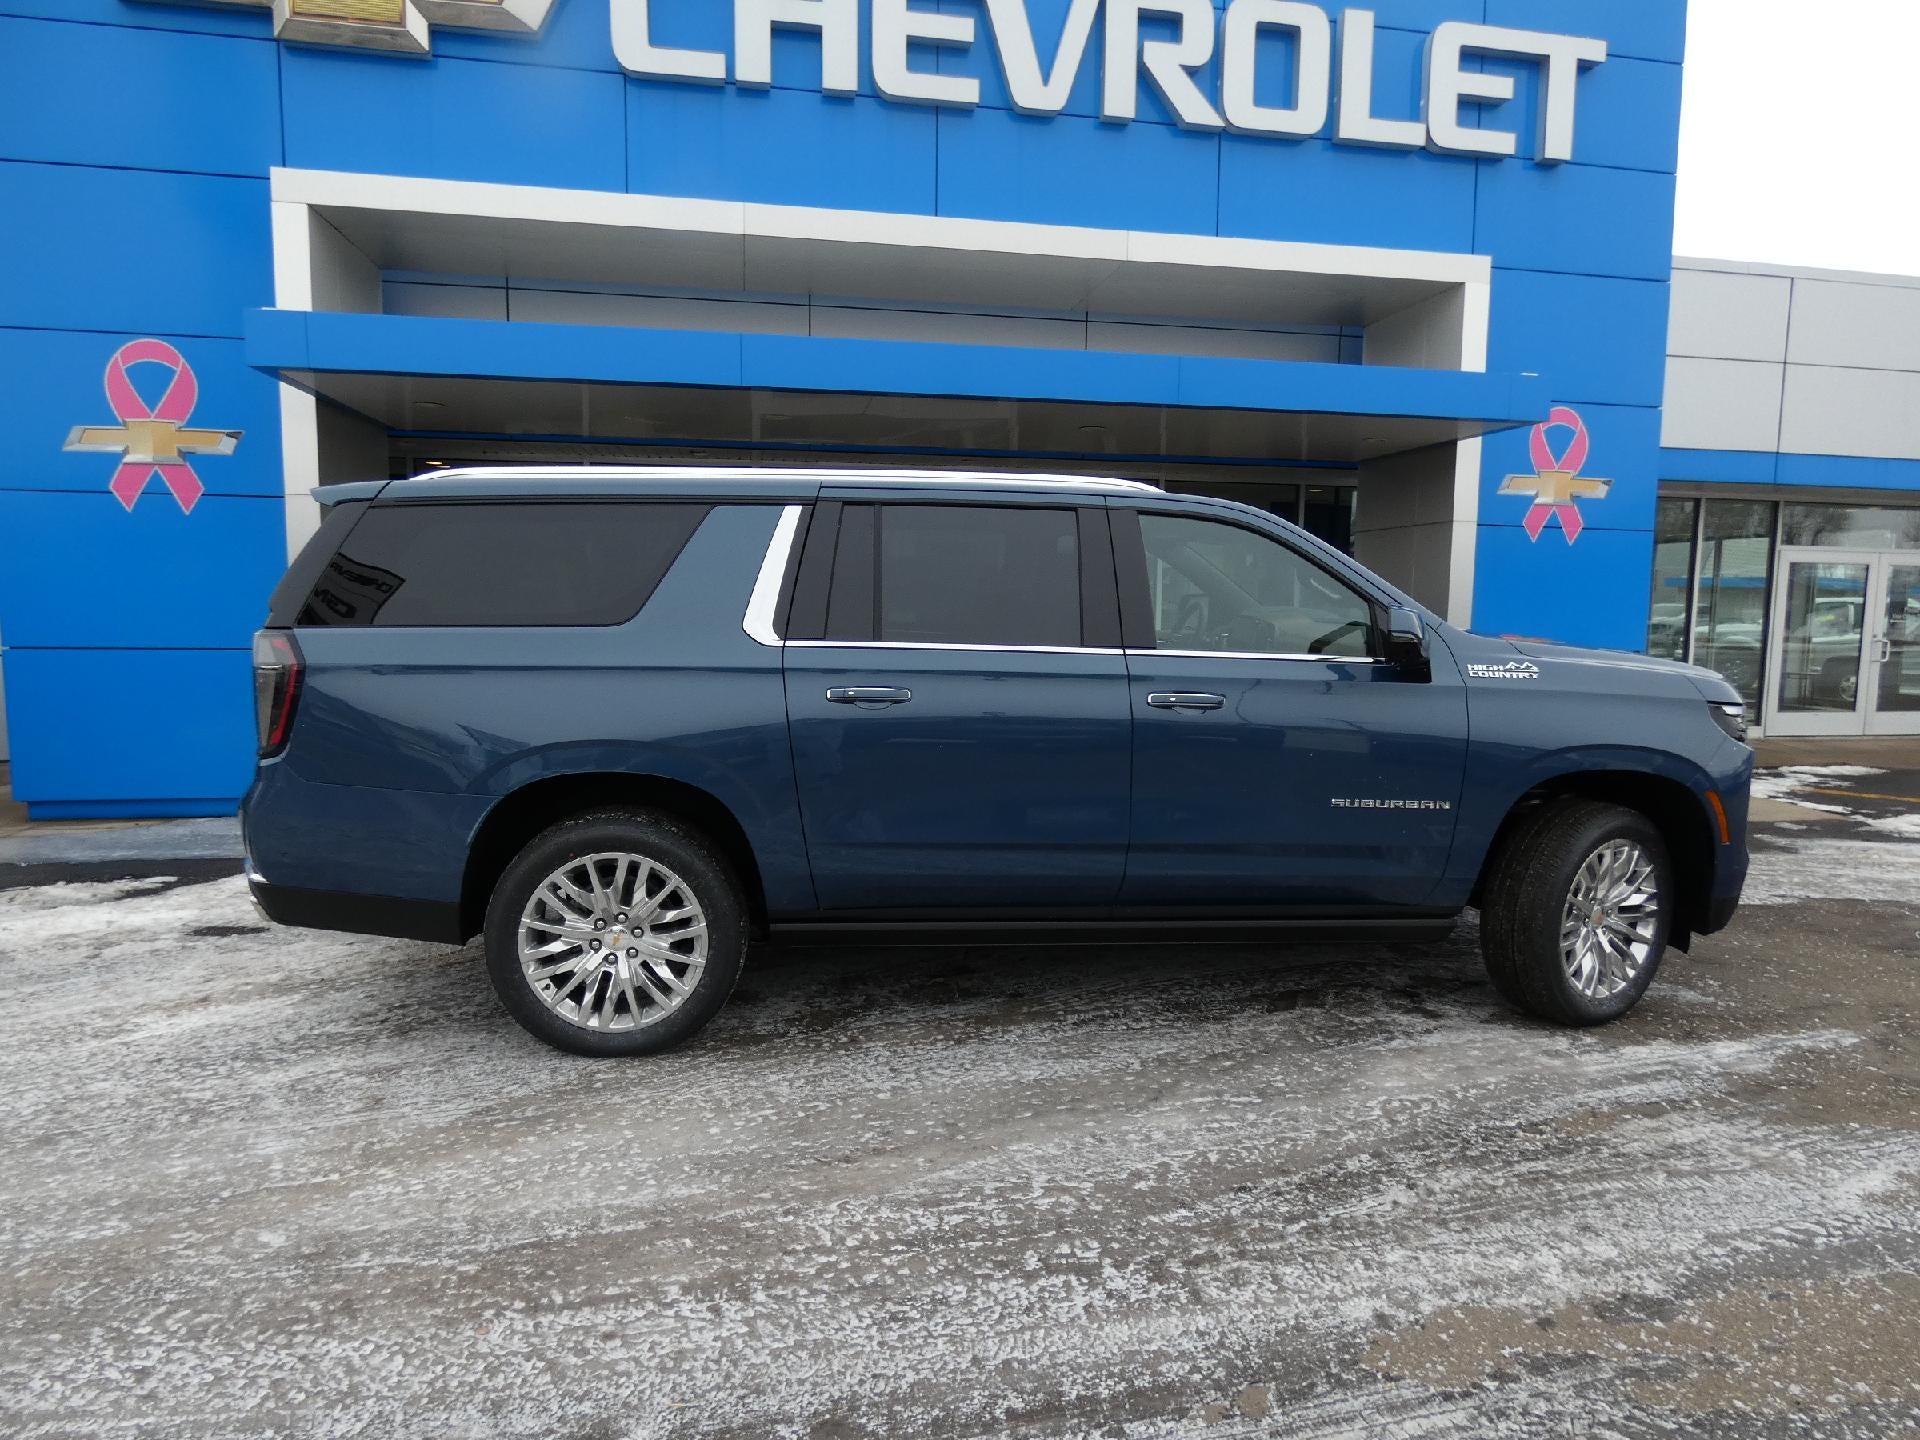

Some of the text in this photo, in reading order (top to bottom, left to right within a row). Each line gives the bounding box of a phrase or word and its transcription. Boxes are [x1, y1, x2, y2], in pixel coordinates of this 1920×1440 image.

[609, 0, 1607, 162] CHEVROLET
[1466, 663, 1504, 671] HIGH
[1468, 670, 1539, 679] COUNTRY
[1330, 798, 1451, 810] SUBURBAN
